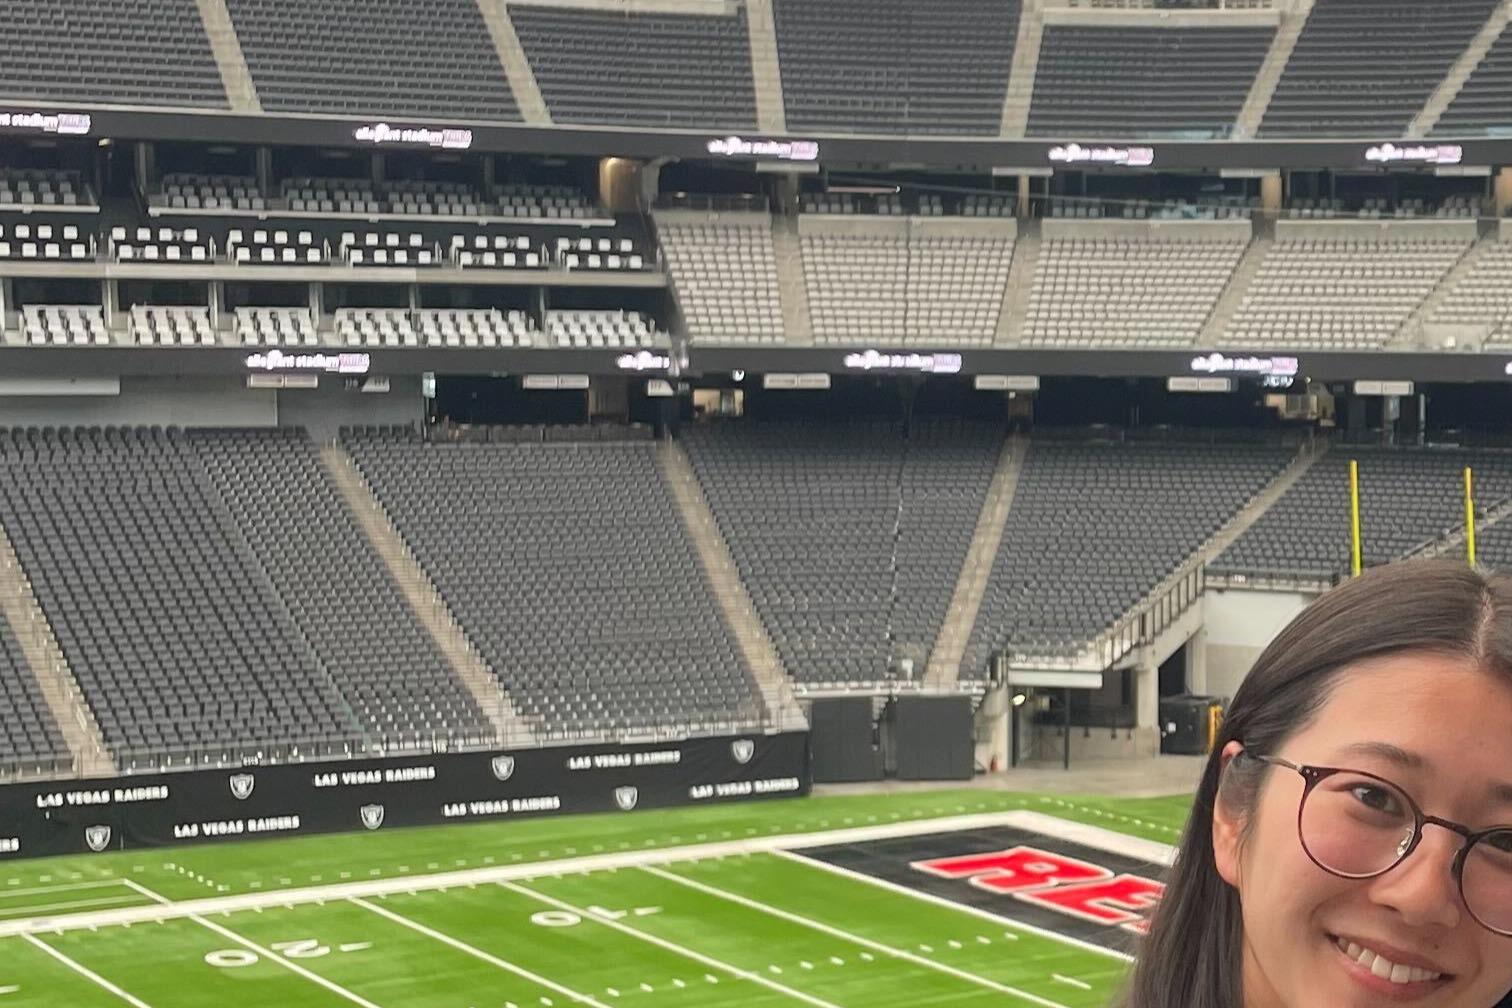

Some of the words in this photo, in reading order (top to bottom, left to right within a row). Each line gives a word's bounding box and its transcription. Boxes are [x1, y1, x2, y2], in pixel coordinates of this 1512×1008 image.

[569, 755, 592, 770] LAS
[594, 752, 632, 768] VEGAS
[314, 772, 339, 787] LAS
[341, 769, 382, 785] VEGAS
[385, 765, 436, 782] RAIDERS
[37, 792, 63, 808] LAS
[66, 789, 111, 806] VEGAS
[114, 785, 169, 803] RAIDERS
[690, 784, 714, 799] LAS
[443, 802, 468, 818] LAS
[470, 799, 509, 815] VEGAS
[512, 795, 561, 812] RAIDERS
[174, 823, 199, 838] LAS
[202, 819, 244, 836] VEGAS
[247, 815, 300, 832] RAIDERS
